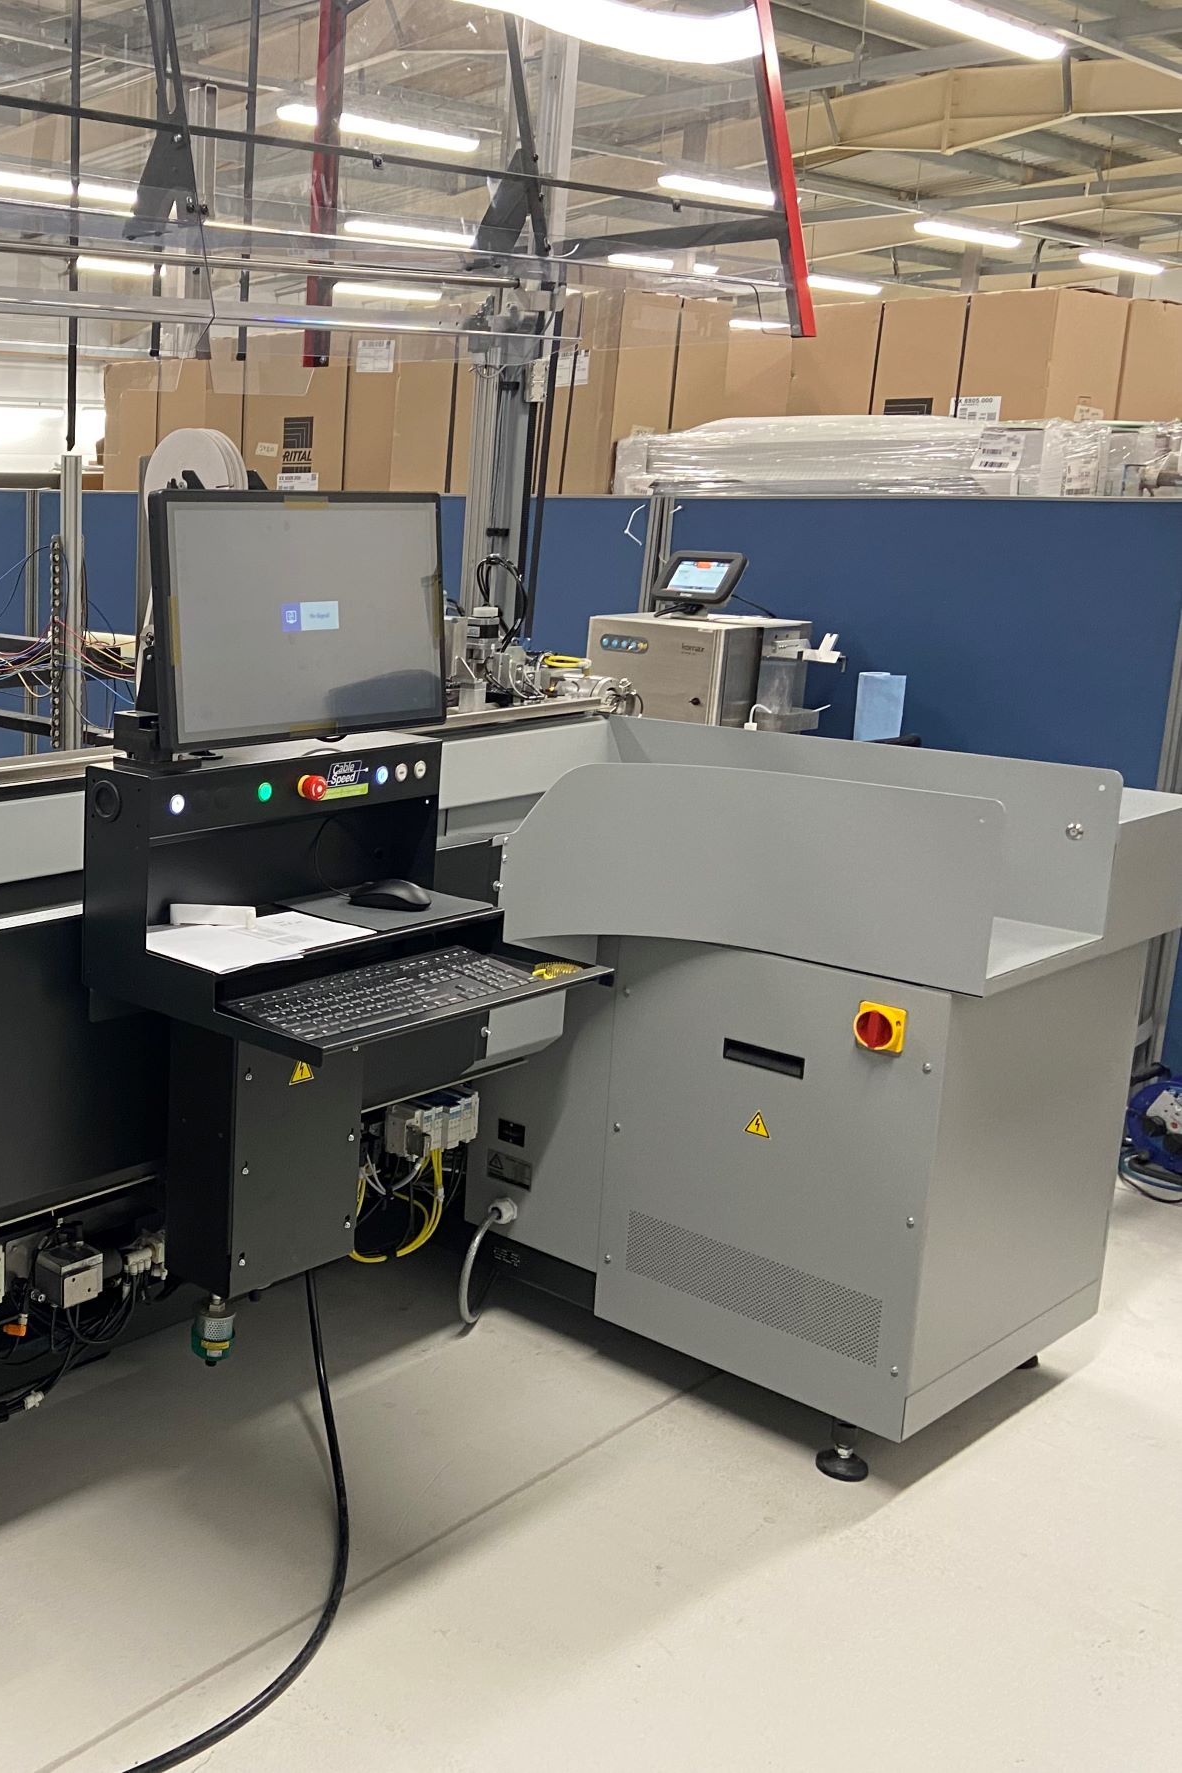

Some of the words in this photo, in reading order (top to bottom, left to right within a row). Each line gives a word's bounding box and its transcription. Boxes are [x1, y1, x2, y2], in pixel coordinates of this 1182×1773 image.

[282, 450, 312, 462] RITTAL
[332, 762, 355, 774] Cable
[330, 772, 356, 786] Speed
